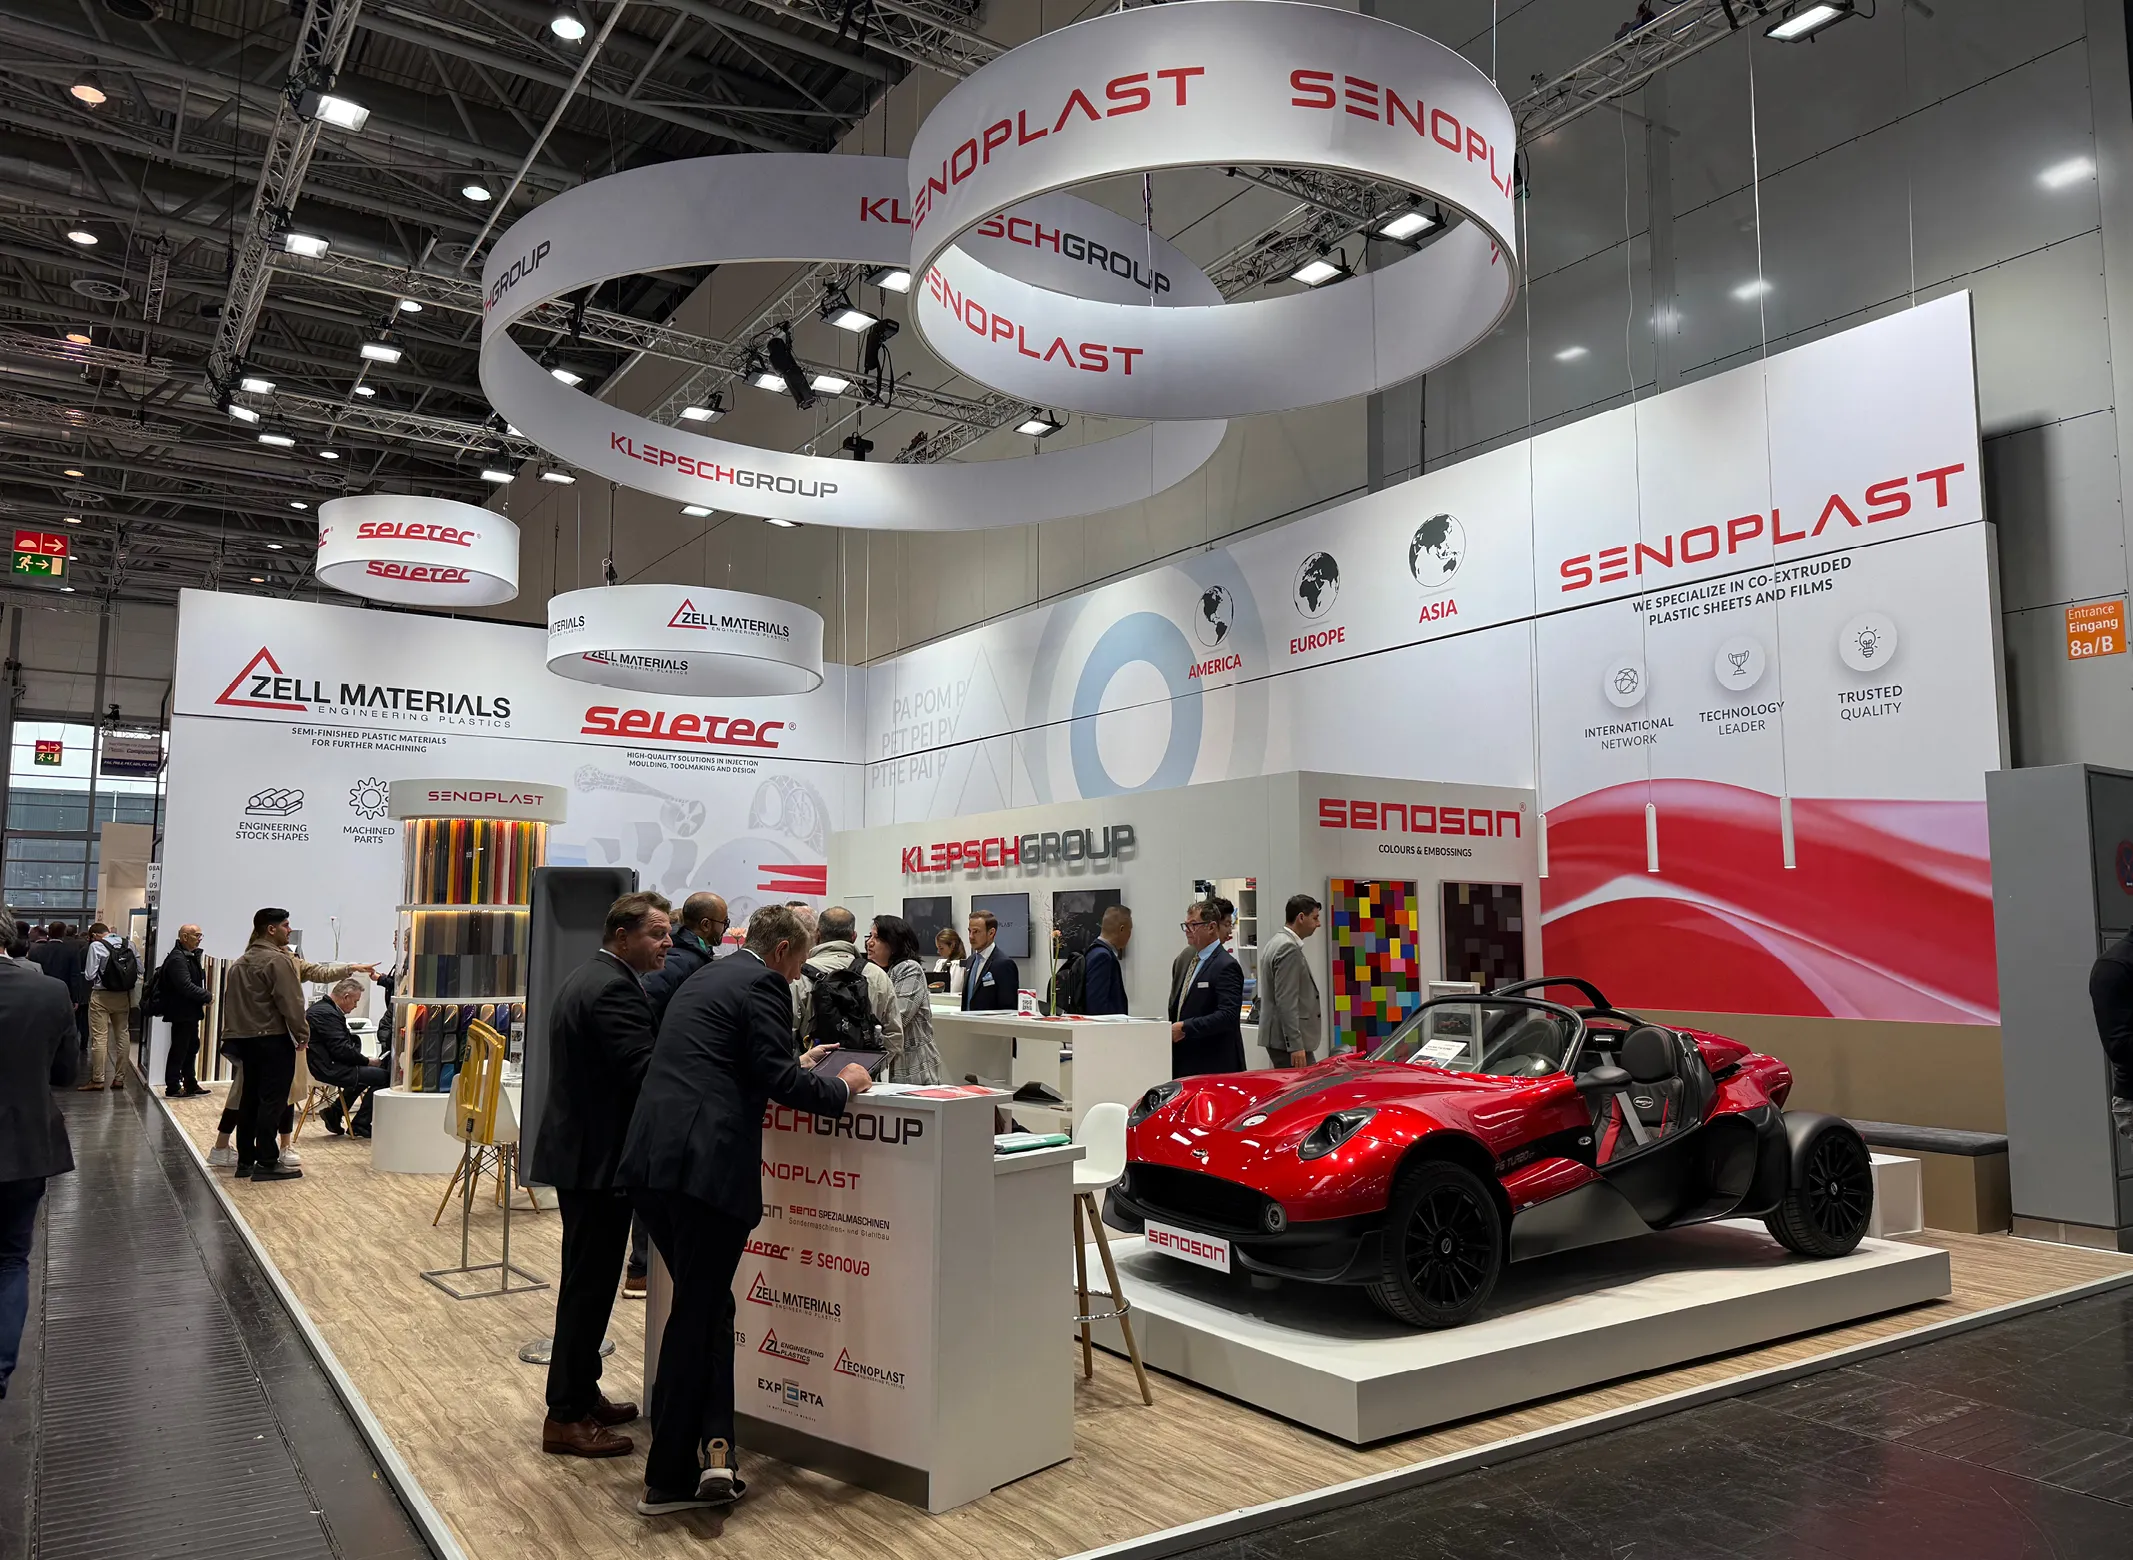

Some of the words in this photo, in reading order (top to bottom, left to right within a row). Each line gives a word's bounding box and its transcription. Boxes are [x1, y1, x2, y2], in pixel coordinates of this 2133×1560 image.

[611, 431, 838, 498] KLEPSCHGROUP
[1560, 462, 1965, 592] SENOPLAST
[1632, 599, 1652, 613] WE
[1655, 583, 1726, 609] SPECIALIZE
[1730, 579, 1744, 593] IN
[1748, 556, 1851, 588] CO-EXTRUDED
[1418, 599, 1458, 624] ASIA
[1649, 605, 1700, 626] PLASTIC
[1703, 594, 1751, 615] SHEETS
[1755, 588, 1786, 605] AND
[1790, 578, 1833, 598] FILMS
[2068, 605, 2115, 620] Entrance
[681, 612, 718, 626] ZELL
[721, 616, 790, 637] MATERIALS
[712, 627, 760, 636] ENGINEERING
[2069, 618, 2119, 633] Eingang
[1290, 626, 1346, 654] EUROPE
[2070, 636, 2114, 657] 8a/B
[612, 662, 654, 672] ENGINEERING
[620, 653, 689, 671] MATERIALS
[1188, 653, 1242, 680] AMERICA
[250, 675, 331, 704] ZELL
[340, 683, 511, 718] MATERIALS
[893, 696, 911, 724] PA
[914, 683, 951, 718] POM
[1838, 684, 1903, 704] TRUSTED
[318, 706, 429, 721] ENGINEERING
[438, 716, 511, 728] PLASTICS
[1698, 701, 1785, 723] TECHNOLOGY
[1840, 701, 1902, 722] QUALITY
[291, 727, 359, 739] SEMI-FINISHED
[361, 732, 397, 742] PLASTIC
[399, 735, 447, 745] MATERIALS
[1584, 717, 1674, 738] INTERNATIONAL
[1718, 719, 1766, 736] LEADER
[311, 738, 330, 747] FOR
[332, 740, 373, 750] FURTHER
[375, 743, 427, 753] MACHINING
[882, 727, 908, 758] PET
[911, 720, 933, 751] PEI
[1600, 733, 1658, 750] NETWORK
[626, 751, 677, 763] HIGH-QUALITY
[677, 755, 715, 765] SOLUTIONS
[716, 757, 723, 765] IN
[725, 758, 759, 767] INJECTION
[629, 760, 669, 770] MOULDING,
[670, 762, 715, 772] TOOLMAKING
[716, 764, 731, 773] AND
[732, 765, 756, 774] DESIGN
[871, 759, 906, 789] PTFE
[909, 753, 932, 782] PAI
[428, 791, 544, 806] SENOPLAST
[235, 831, 269, 840] STOCK
[271, 832, 310, 842] SHAPES
[239, 821, 307, 832] ENGINEERING
[343, 826, 395, 836] MACHINED
[354, 835, 384, 844] PARTS
[901, 824, 1135, 874] KLEPSCHGROUP
[1378, 844, 1415, 855] COLOURS
[1416, 847, 1422, 855] &
[1424, 847, 1473, 857] EMBOSSINGS
[818, 1209, 890, 1230] SPEZIALMASCHINEN
[817, 1252, 870, 1277] senova
[755, 1286, 781, 1303] ZELL
[782, 1292, 841, 1317] MATERIALS
[765, 1339, 781, 1354] ZL
[780, 1341, 824, 1359] ENGINEERING
[780, 1350, 811, 1363] PLASTICS
[841, 1359, 905, 1385] TECNOPLAST
